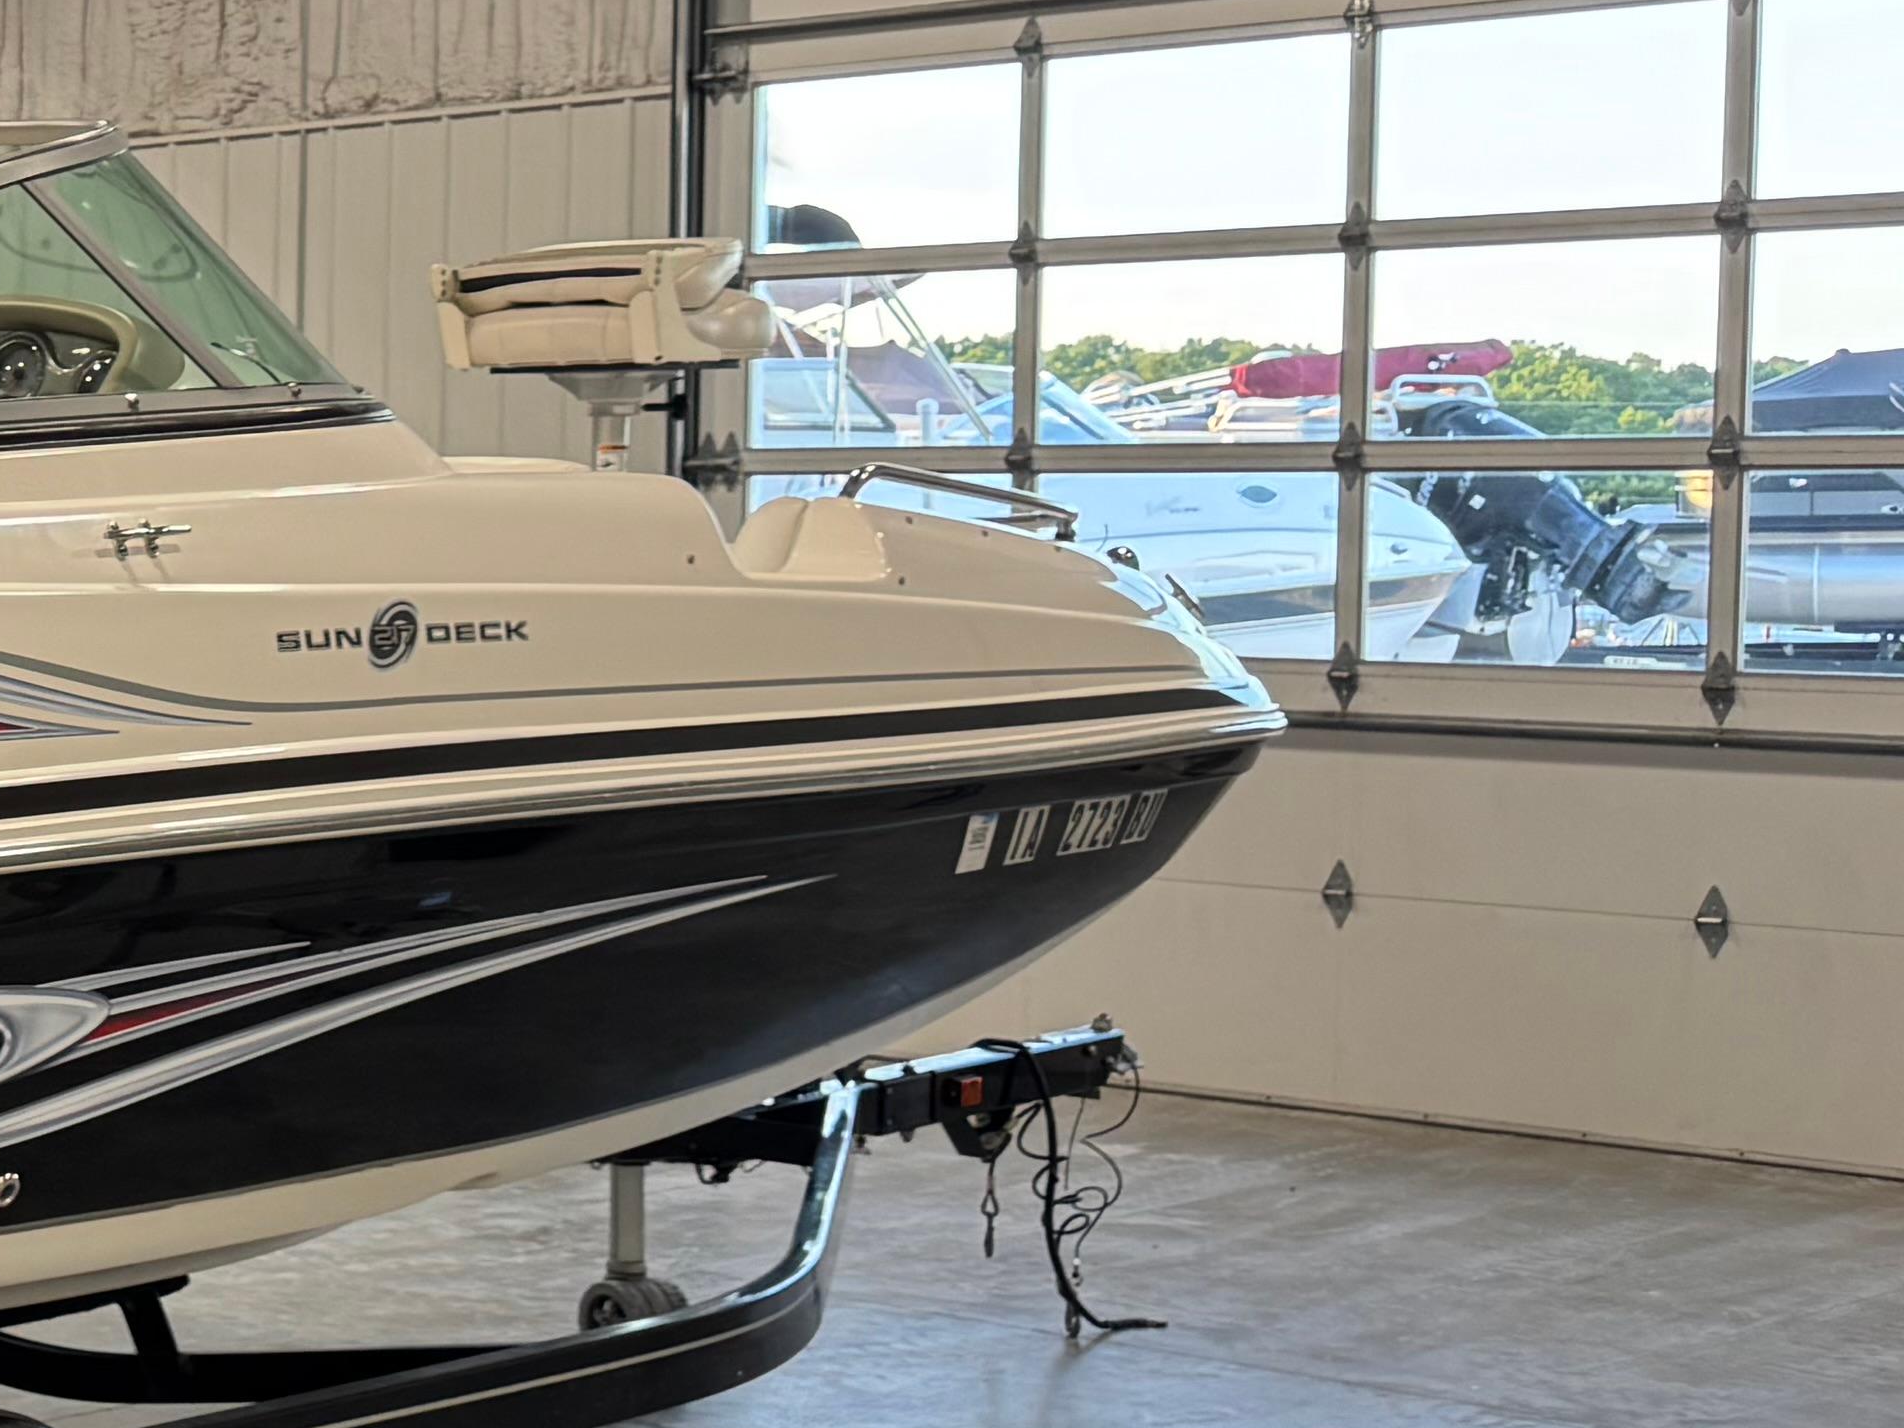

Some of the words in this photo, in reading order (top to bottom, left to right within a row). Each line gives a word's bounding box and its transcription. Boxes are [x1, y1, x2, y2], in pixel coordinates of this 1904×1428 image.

[276, 628, 363, 653] SUN
[426, 621, 530, 644] DECK
[1006, 806, 1049, 863] IA
[1058, 796, 1129, 854] 2723
